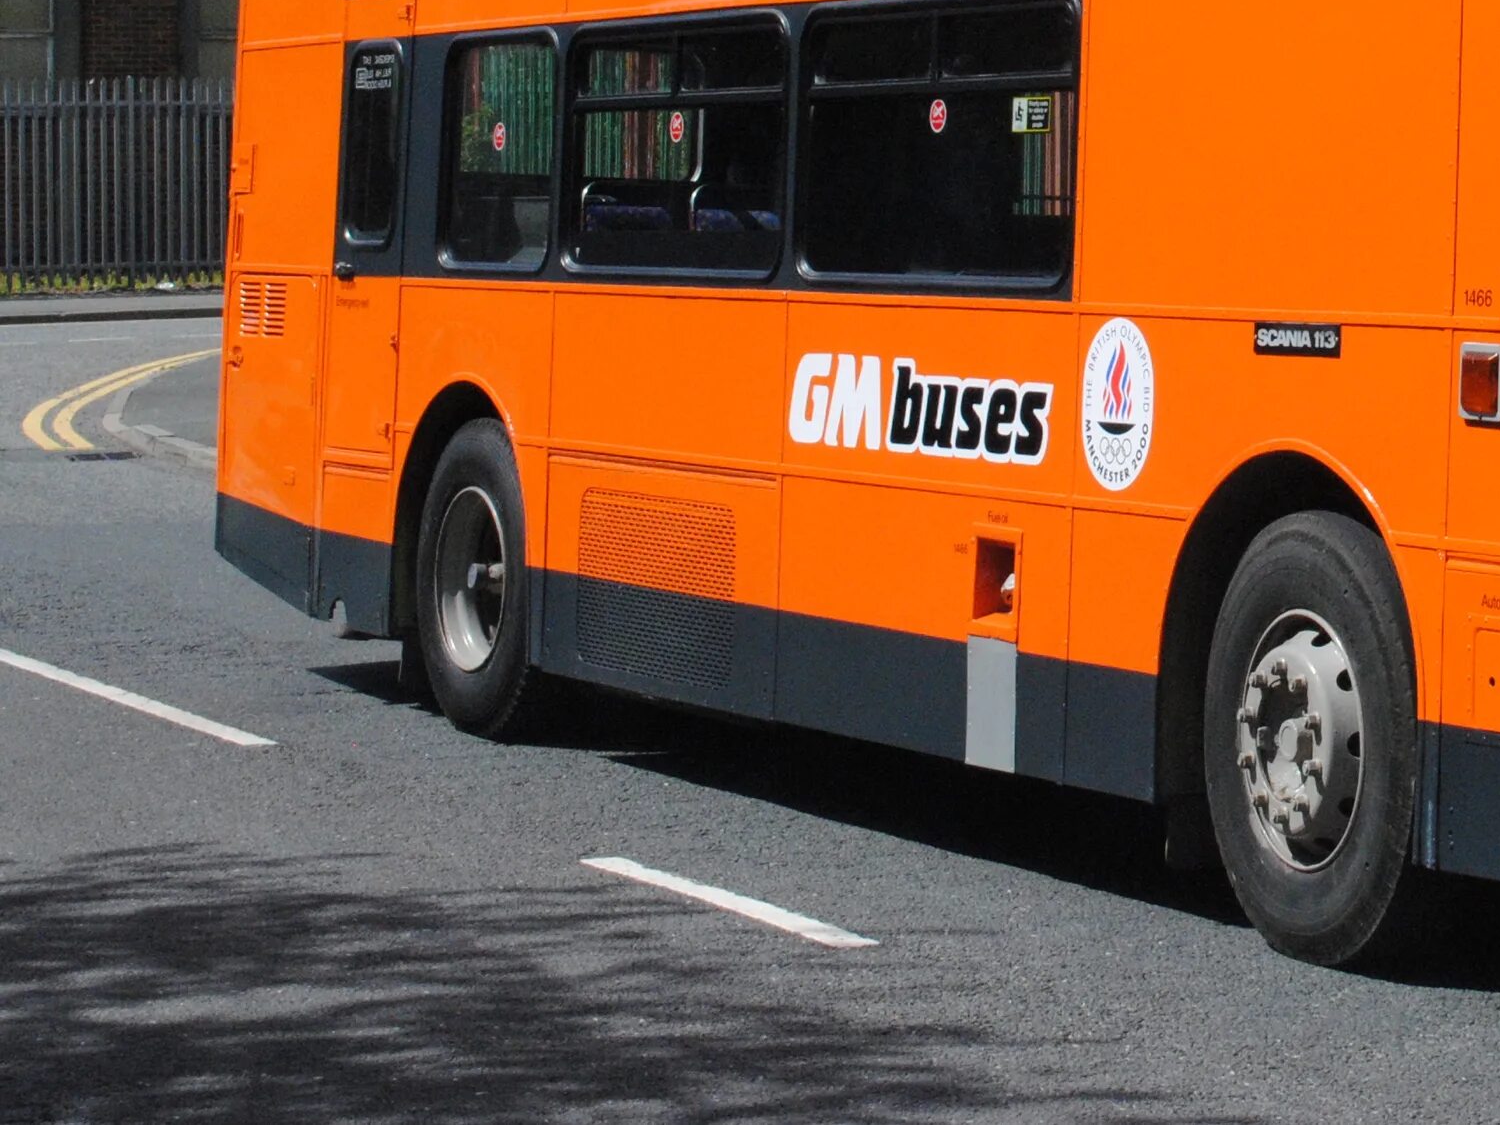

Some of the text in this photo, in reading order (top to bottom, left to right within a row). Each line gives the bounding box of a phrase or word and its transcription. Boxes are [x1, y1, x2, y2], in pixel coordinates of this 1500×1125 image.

[1464, 289, 1493, 308] 1466
[1120, 325, 1151, 380] OLYMPIC
[1256, 328, 1337, 349] SCANIA 113
[788, 352, 1055, 465] GM buses
[1085, 418, 1149, 483] MANCHESTER 2000
